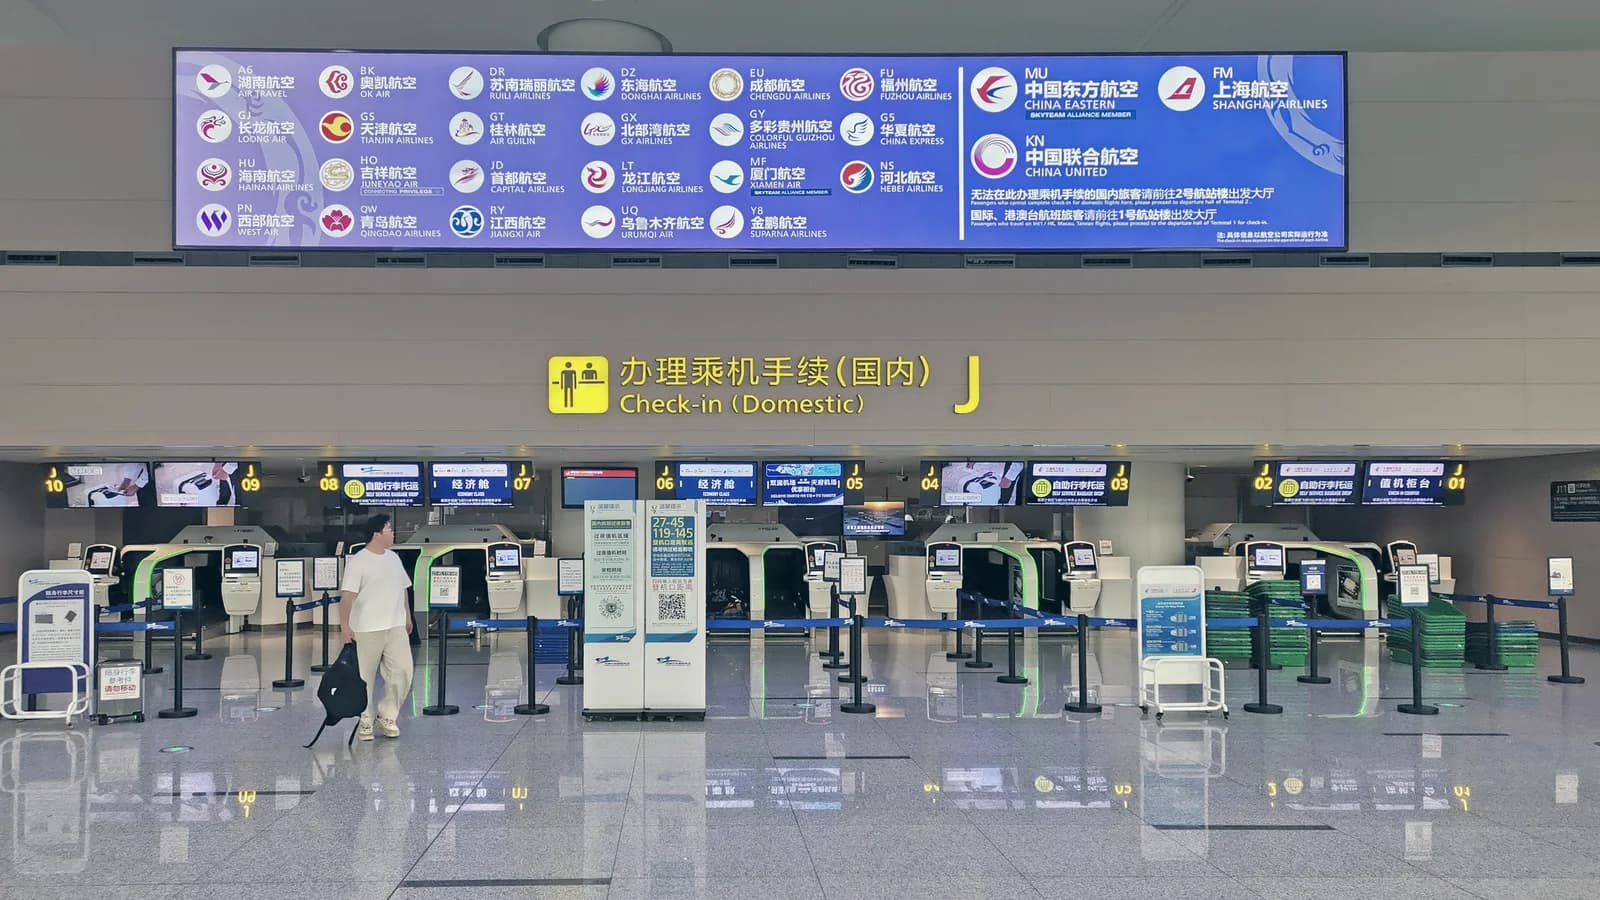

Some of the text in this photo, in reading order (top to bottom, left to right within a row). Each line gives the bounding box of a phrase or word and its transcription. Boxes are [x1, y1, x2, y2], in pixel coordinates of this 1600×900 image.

[238, 65, 254, 75] A6
[360, 66, 375, 75] BK
[490, 67, 505, 76] DR
[621, 68, 636, 77] DZ
[750, 68, 764, 77] EU
[880, 69, 894, 77] FU
[1025, 67, 1048, 79] MU
[1213, 67, 1233, 78] FM
[238, 76, 294, 89] 湖南航空
[360, 76, 416, 89] 奥凯航空
[490, 78, 575, 93] 苏南瑞丽航空
[621, 78, 676, 92] 东海航空
[750, 79, 805, 92] 成都航空
[881, 78, 938, 92] 福州航空
[238, 90, 288, 98] AIR TRAVEL
[360, 89, 390, 98] OK AIR
[1025, 80, 1138, 98] 中国东方航空
[1213, 79, 1290, 99] 上海航空
[490, 91, 551, 100] RUILI AIRLINES
[1025, 100, 1115, 110] CHINA EASTERN
[1213, 100, 1328, 110] SHANGHAI AIRLINES
[238, 112, 252, 121] GJ
[361, 112, 375, 121] GS
[490, 112, 504, 121] GT
[621, 113, 637, 122] GX
[750, 109, 765, 118] GY
[880, 113, 895, 122] G5
[238, 122, 294, 136] 长龙航空
[360, 122, 416, 136] 天津航空
[490, 123, 546, 136] 桂林航空
[621, 123, 690, 136] 北部湾航空
[750, 120, 832, 133] 多彩贵州航空
[880, 123, 935, 137] 华夏航空
[238, 135, 287, 144] LOONG AIR
[621, 136, 672, 144] GX AIRLINES
[750, 134, 835, 143] COLORFUL GUIZHOU
[1026, 135, 1044, 146] KN
[361, 156, 377, 165] HO
[750, 157, 766, 166] MF
[1026, 148, 1138, 166] 中国联合航空
[239, 159, 255, 168] HU
[490, 161, 503, 169] JD
[622, 161, 634, 170] LT
[880, 161, 894, 170] NS
[238, 169, 295, 183] 海南航空
[360, 166, 416, 180] 吉祥航空
[750, 167, 805, 180] 厦门航空
[1025, 167, 1107, 176] CHINA UNITED
[490, 171, 546, 185] 首都航空
[622, 172, 680, 185] 龙江航空
[880, 171, 935, 184] 河北航空
[239, 184, 314, 192] HAINAN AIRLINES
[360, 180, 418, 188] JUNEYAO AIR
[490, 184, 565, 192] CAPITAL AIRLINES
[622, 185, 703, 193] LONGJIANG AIRLINES
[750, 181, 801, 189] XIAMEN AIR
[238, 204, 252, 213] PN
[360, 205, 377, 214] QW
[490, 206, 504, 215] RY
[622, 206, 638, 215] UQ
[750, 206, 763, 215] Y8
[238, 214, 295, 227] 西部航空
[360, 216, 417, 229] 青岛航空
[490, 216, 546, 229] 江西航空
[621, 217, 704, 230] 乌鲁木齐航空
[751, 216, 807, 229] 金鹏航空
[238, 228, 279, 236] WEST AIR
[360, 230, 441, 239] QINGDAO AIRLINES
[490, 229, 540, 239] JIANGXI AIR
[622, 231, 673, 240] URUMQI AIR
[750, 230, 827, 239] SUPARNA AIRLINES
[619, 355, 930, 387] 办理乘机手续(国内)
[953, 355, 980, 415] J
[620, 394, 865, 415] Check-in (Domestic)
[50, 468, 57, 478] J
[246, 465, 253, 477] J
[325, 465, 332, 477] J
[519, 464, 526, 476] J
[662, 465, 669, 476] J
[852, 464, 859, 475] J
[928, 466, 934, 476] J
[1118, 465, 1124, 476] J
[1262, 464, 1269, 476] J
[1454, 464, 1463, 476] J
[45, 480, 63, 492] 10
[242, 478, 260, 491] 09
[320, 478, 338, 491] 08
[452, 480, 490, 489] 经济舱
[514, 478, 532, 490] 07
[657, 478, 673, 490] 06
[698, 480, 735, 489] 经济舱
[847, 478, 863, 490] 05
[921, 479, 938, 490] 04
[1111, 478, 1128, 490] 03
[1255, 477, 1272, 489] 02
[1380, 479, 1430, 489] 值机柜台
[1448, 478, 1465, 489] 01
[652, 517, 684, 528] 27-45
[653, 528, 693, 538] 119-145
